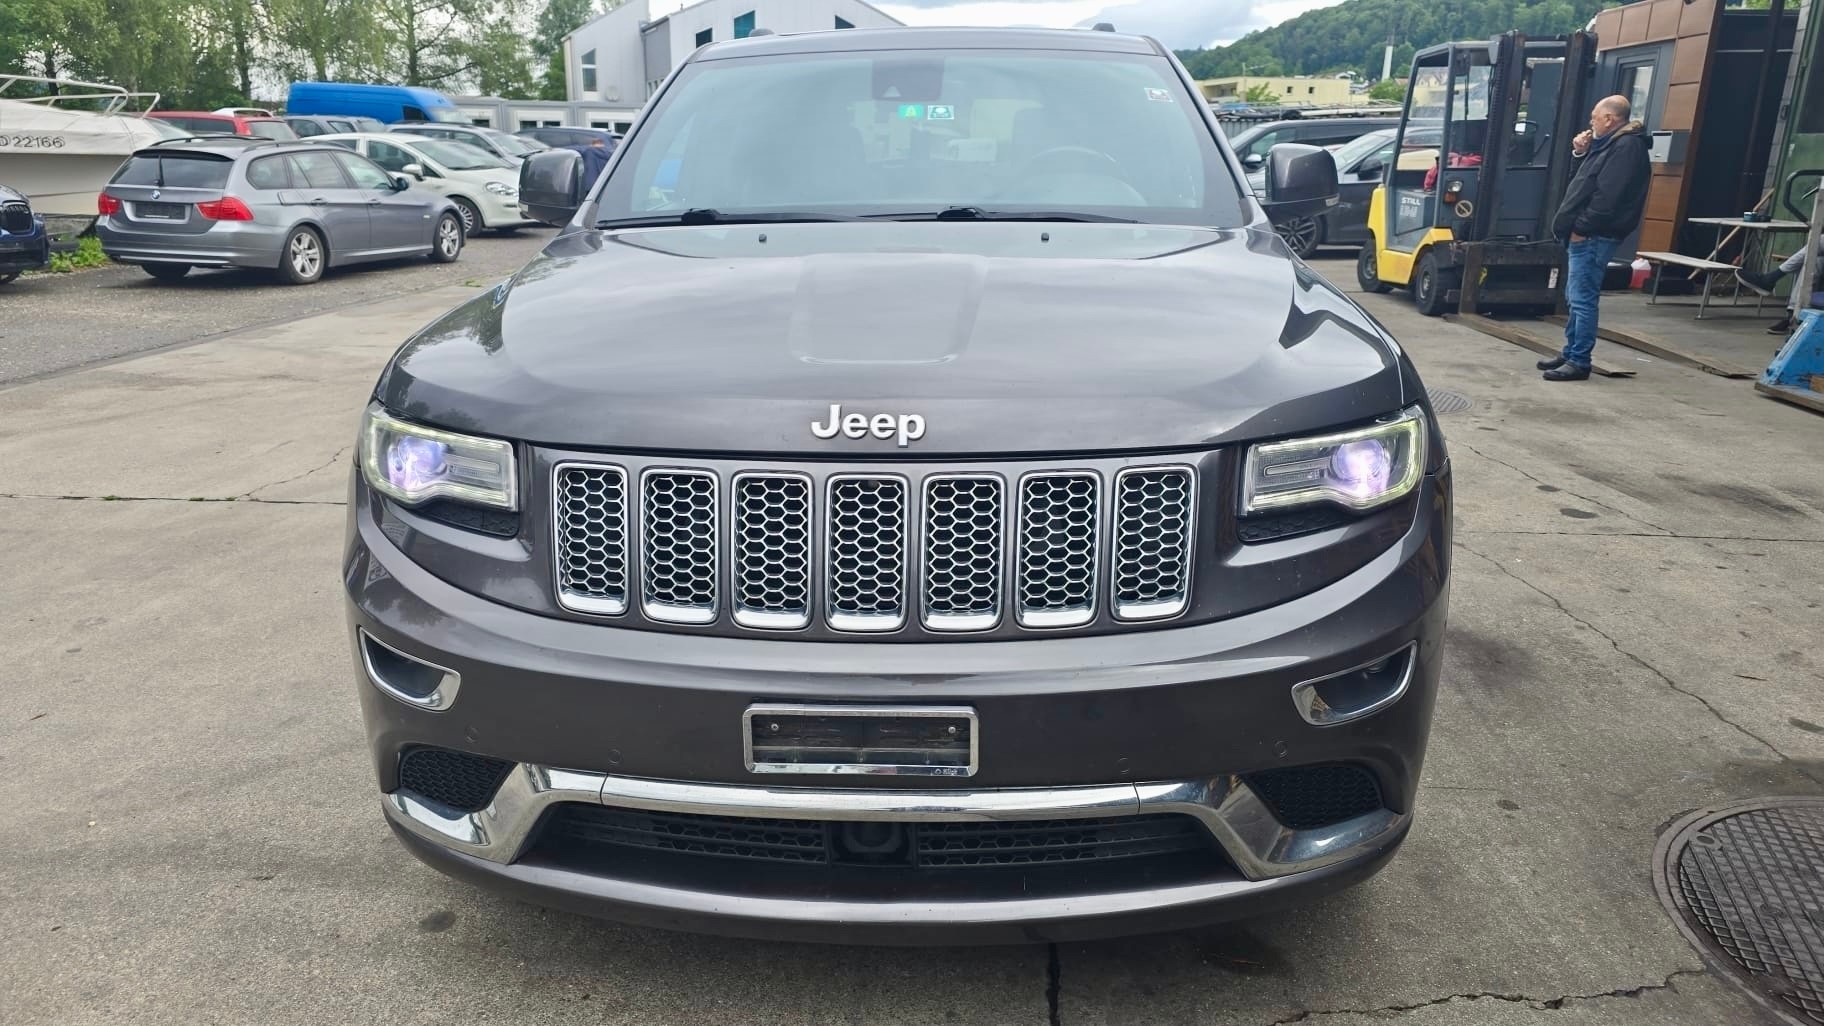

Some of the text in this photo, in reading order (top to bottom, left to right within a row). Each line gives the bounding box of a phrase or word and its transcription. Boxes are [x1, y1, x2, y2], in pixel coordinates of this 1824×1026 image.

[12, 135, 65, 148] 22166
[1401, 197, 1421, 206] STILL
[811, 404, 926, 447] Jeep
